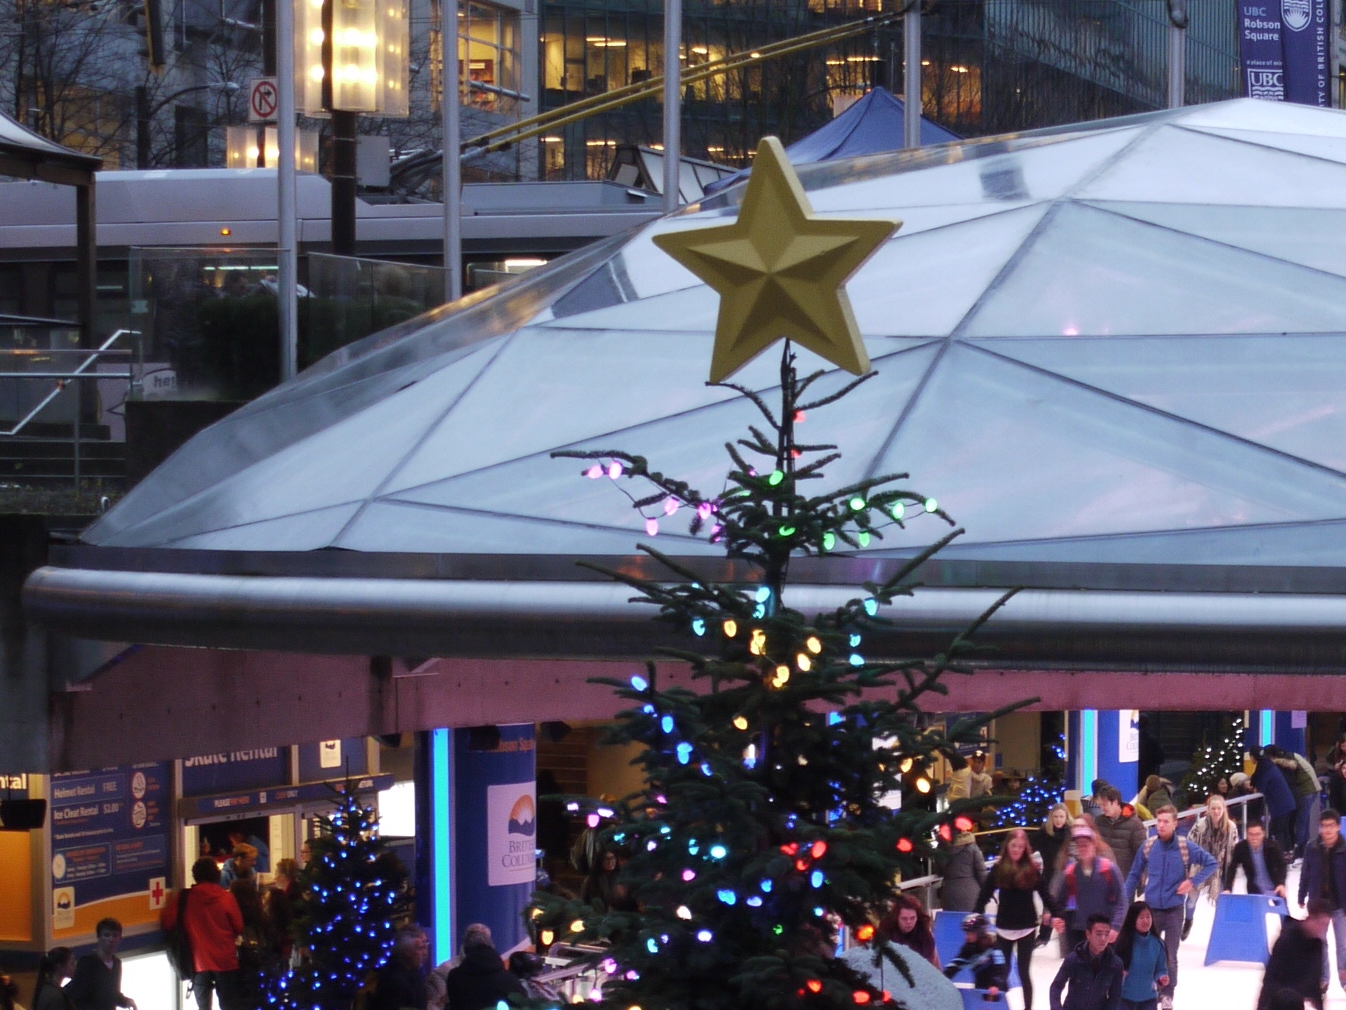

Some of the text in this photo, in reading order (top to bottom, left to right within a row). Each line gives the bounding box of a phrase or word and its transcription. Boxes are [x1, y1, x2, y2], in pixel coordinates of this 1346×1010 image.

[1244, 7, 1267, 17] UBC
[1244, 18, 1281, 30] Robson
[1244, 30, 1280, 42] Square
[1316, 27, 1325, 70] BRITISH
[1251, 72, 1284, 87] UBC
[1317, 73, 1325, 88] OF
[77, 784, 96, 796] Rental
[54, 809, 63, 820] Ice
[80, 804, 99, 817] Rental
